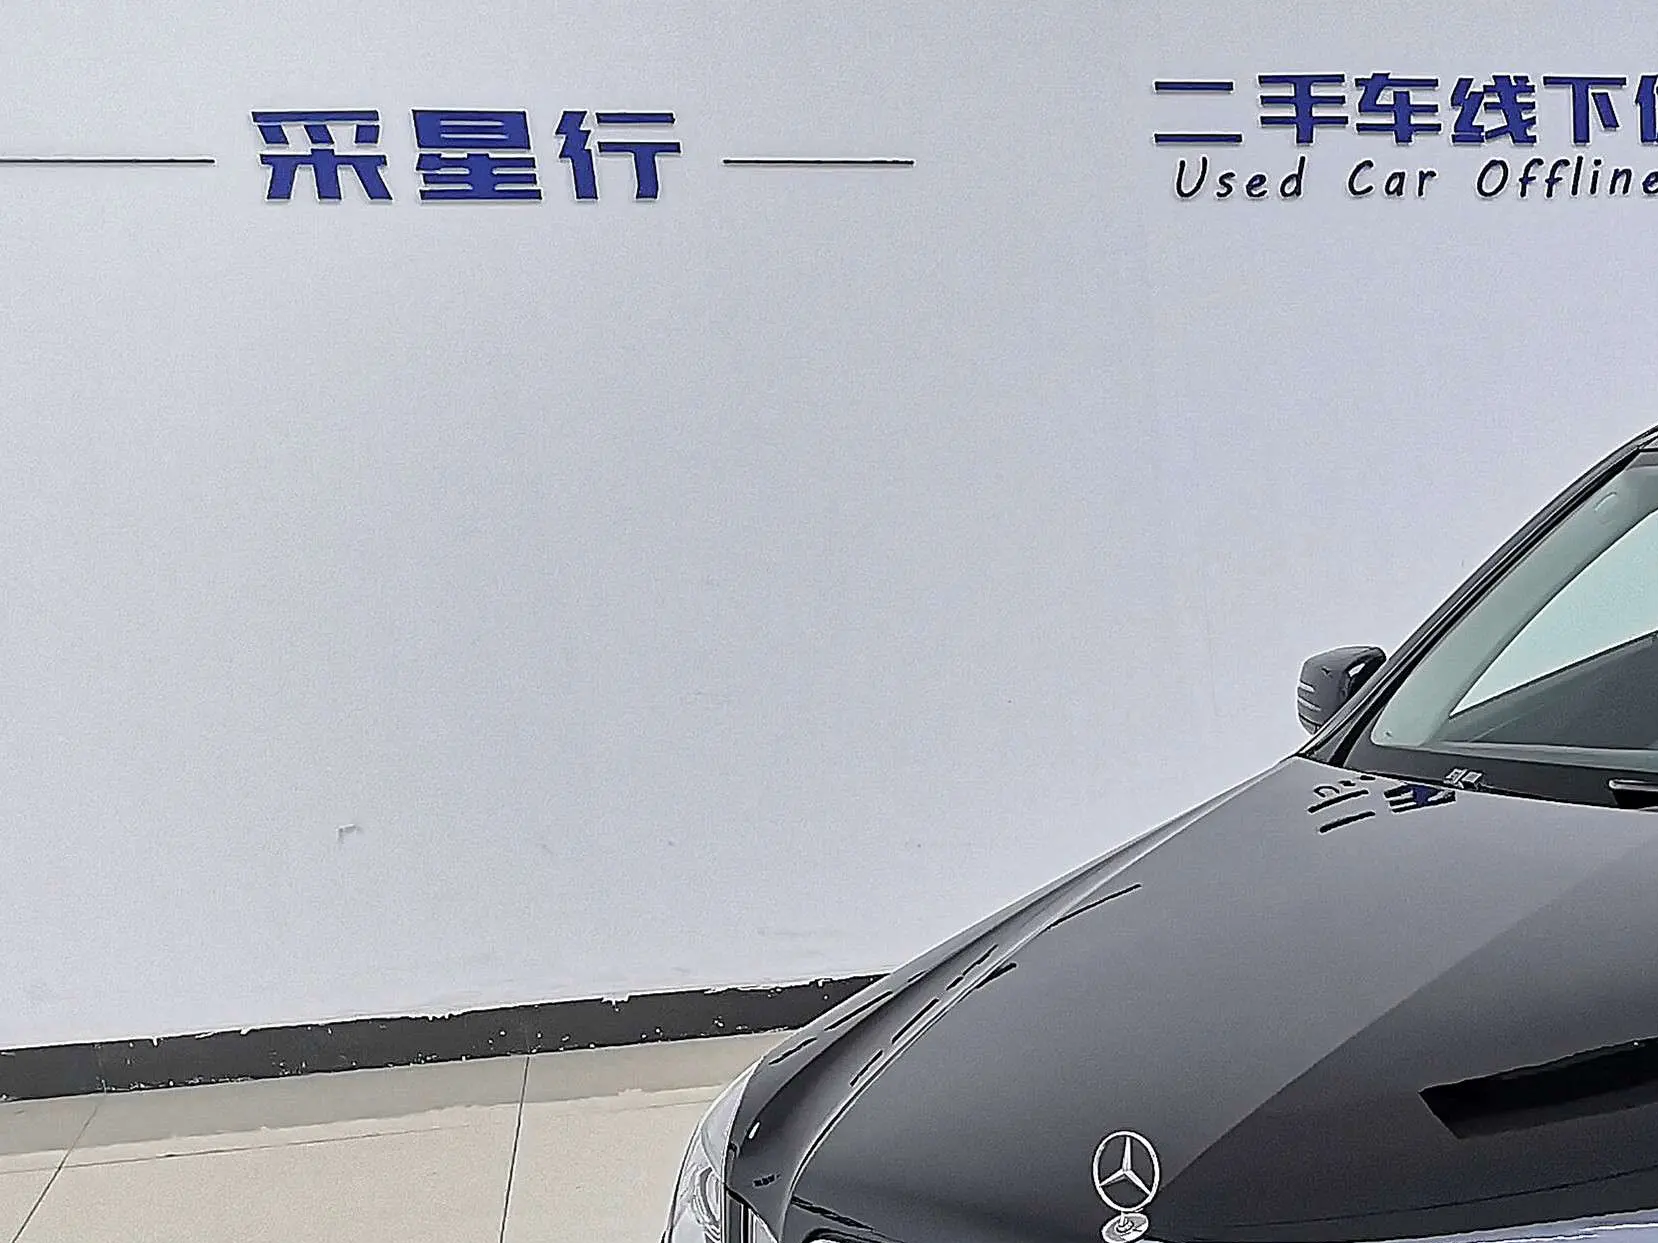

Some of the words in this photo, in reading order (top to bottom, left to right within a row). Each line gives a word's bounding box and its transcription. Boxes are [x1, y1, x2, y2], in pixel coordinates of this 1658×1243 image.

[251, 108, 682, 201] 采星行
[1175, 155, 1306, 199] Used
[1347, 159, 1437, 198] Car
